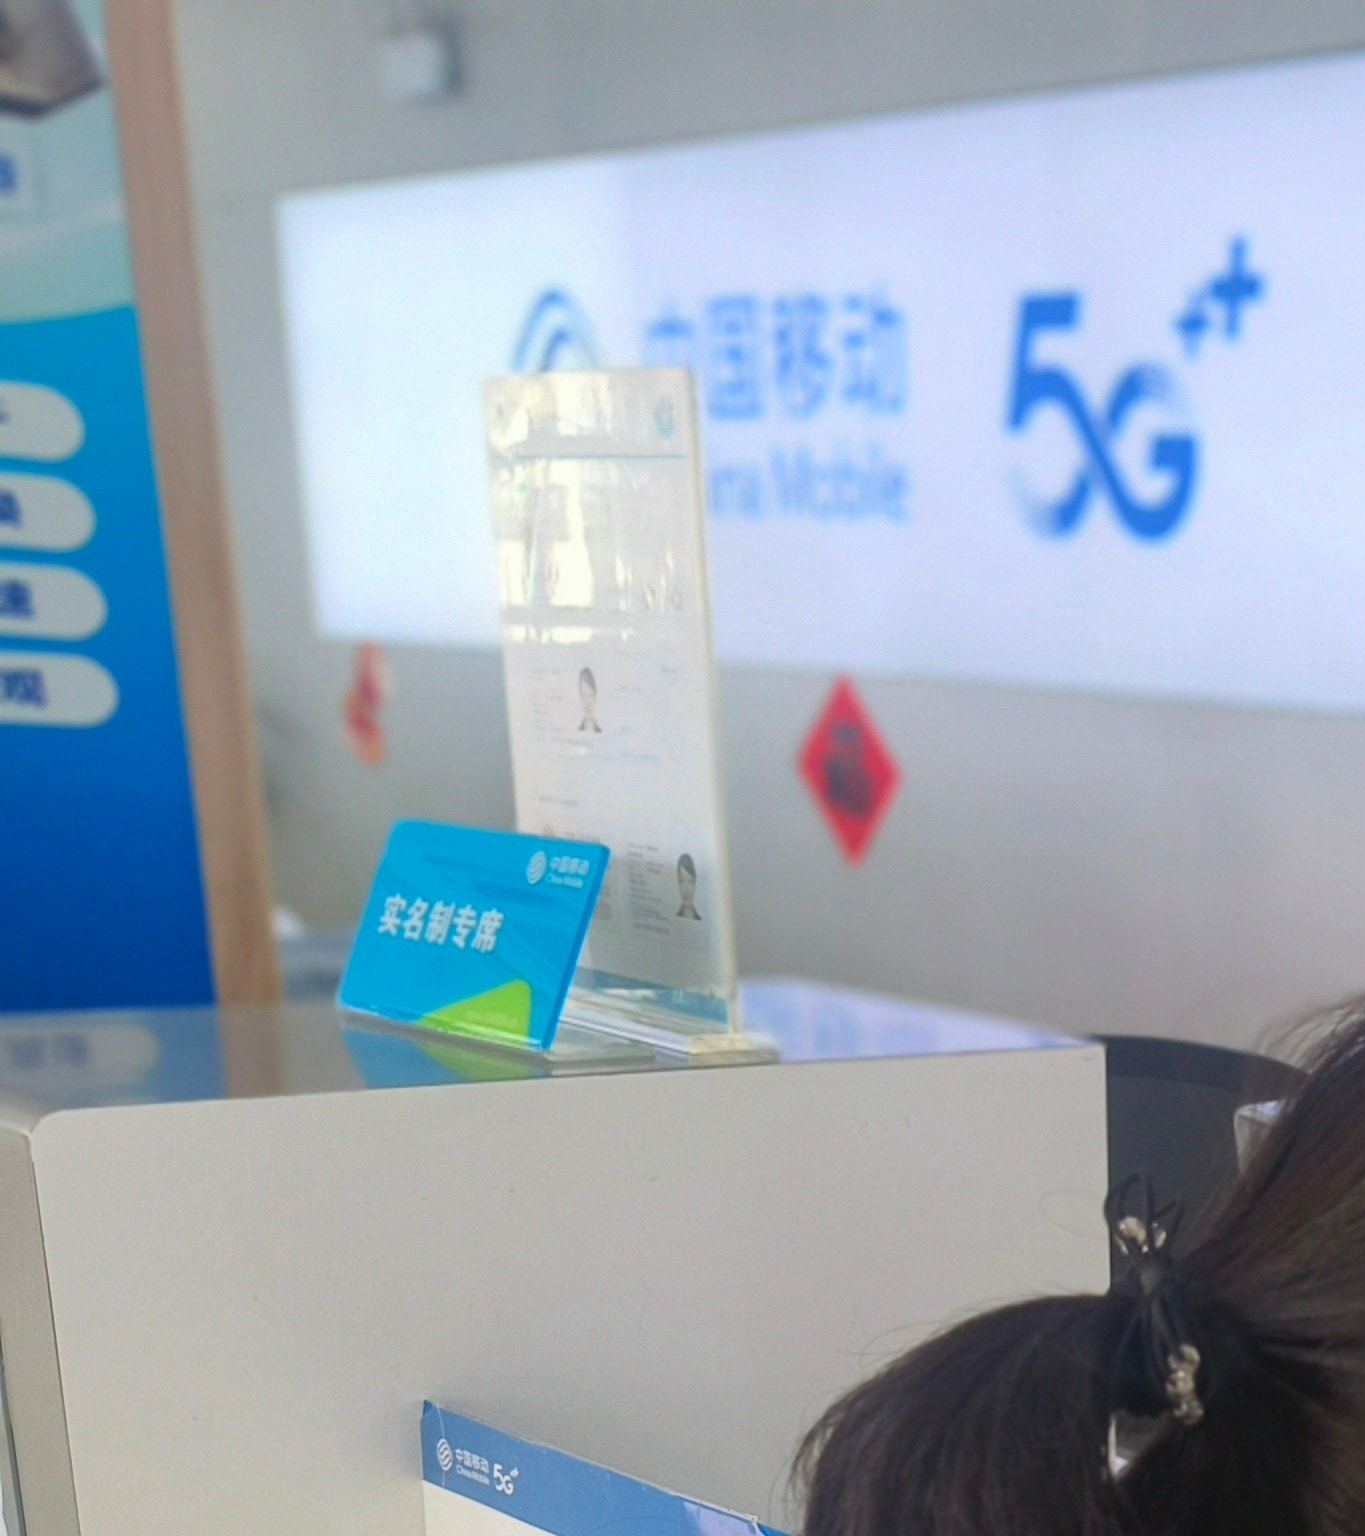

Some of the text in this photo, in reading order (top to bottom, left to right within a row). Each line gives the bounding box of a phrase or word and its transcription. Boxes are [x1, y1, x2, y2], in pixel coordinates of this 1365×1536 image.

[378, 894, 505, 954] 实名制专席
